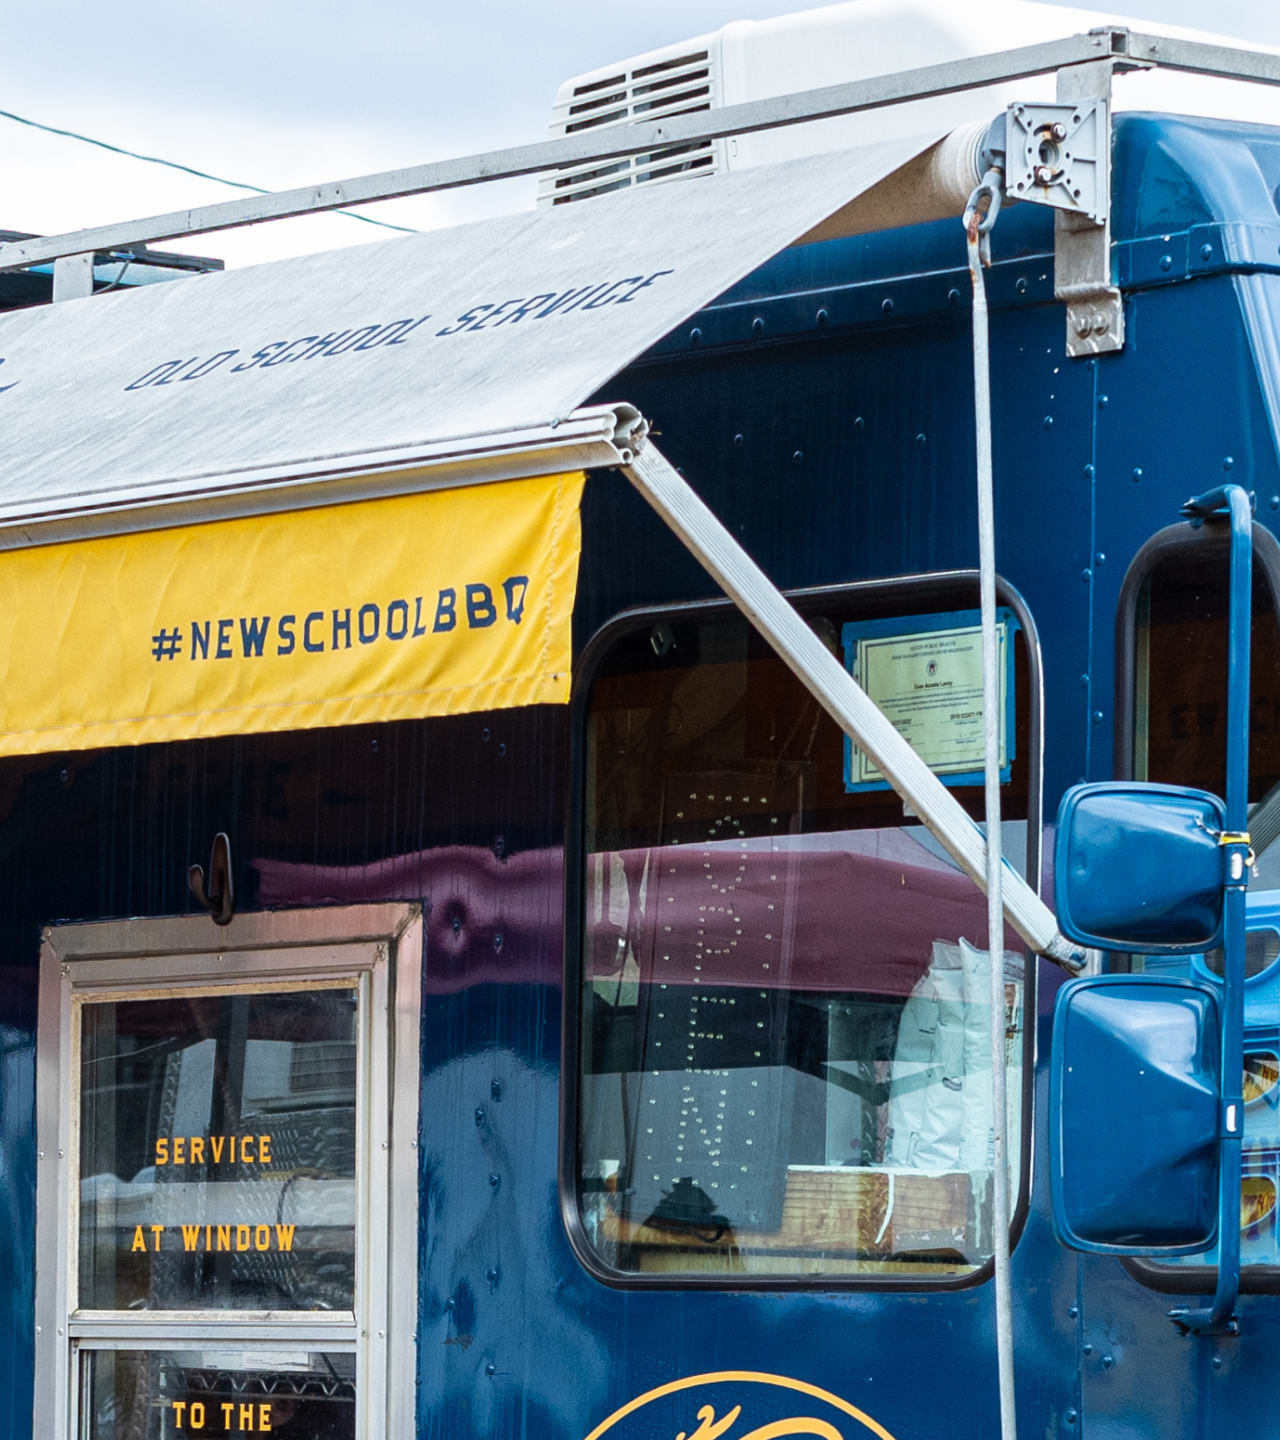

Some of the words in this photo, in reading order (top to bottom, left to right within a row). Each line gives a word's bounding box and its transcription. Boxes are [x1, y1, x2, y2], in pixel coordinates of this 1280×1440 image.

[123, 349, 241, 391] OLD
[230, 315, 433, 373] SCHOOL
[435, 269, 675, 338] SERVICE
[151, 575, 530, 662] #NEWSCHOOLBBQ
[155, 1135, 272, 1166] SERVICE
[131, 1223, 164, 1253] AT
[181, 1223, 296, 1253] WINDOW
[172, 1402, 205, 1430] TO
[221, 1402, 272, 1432] THE
